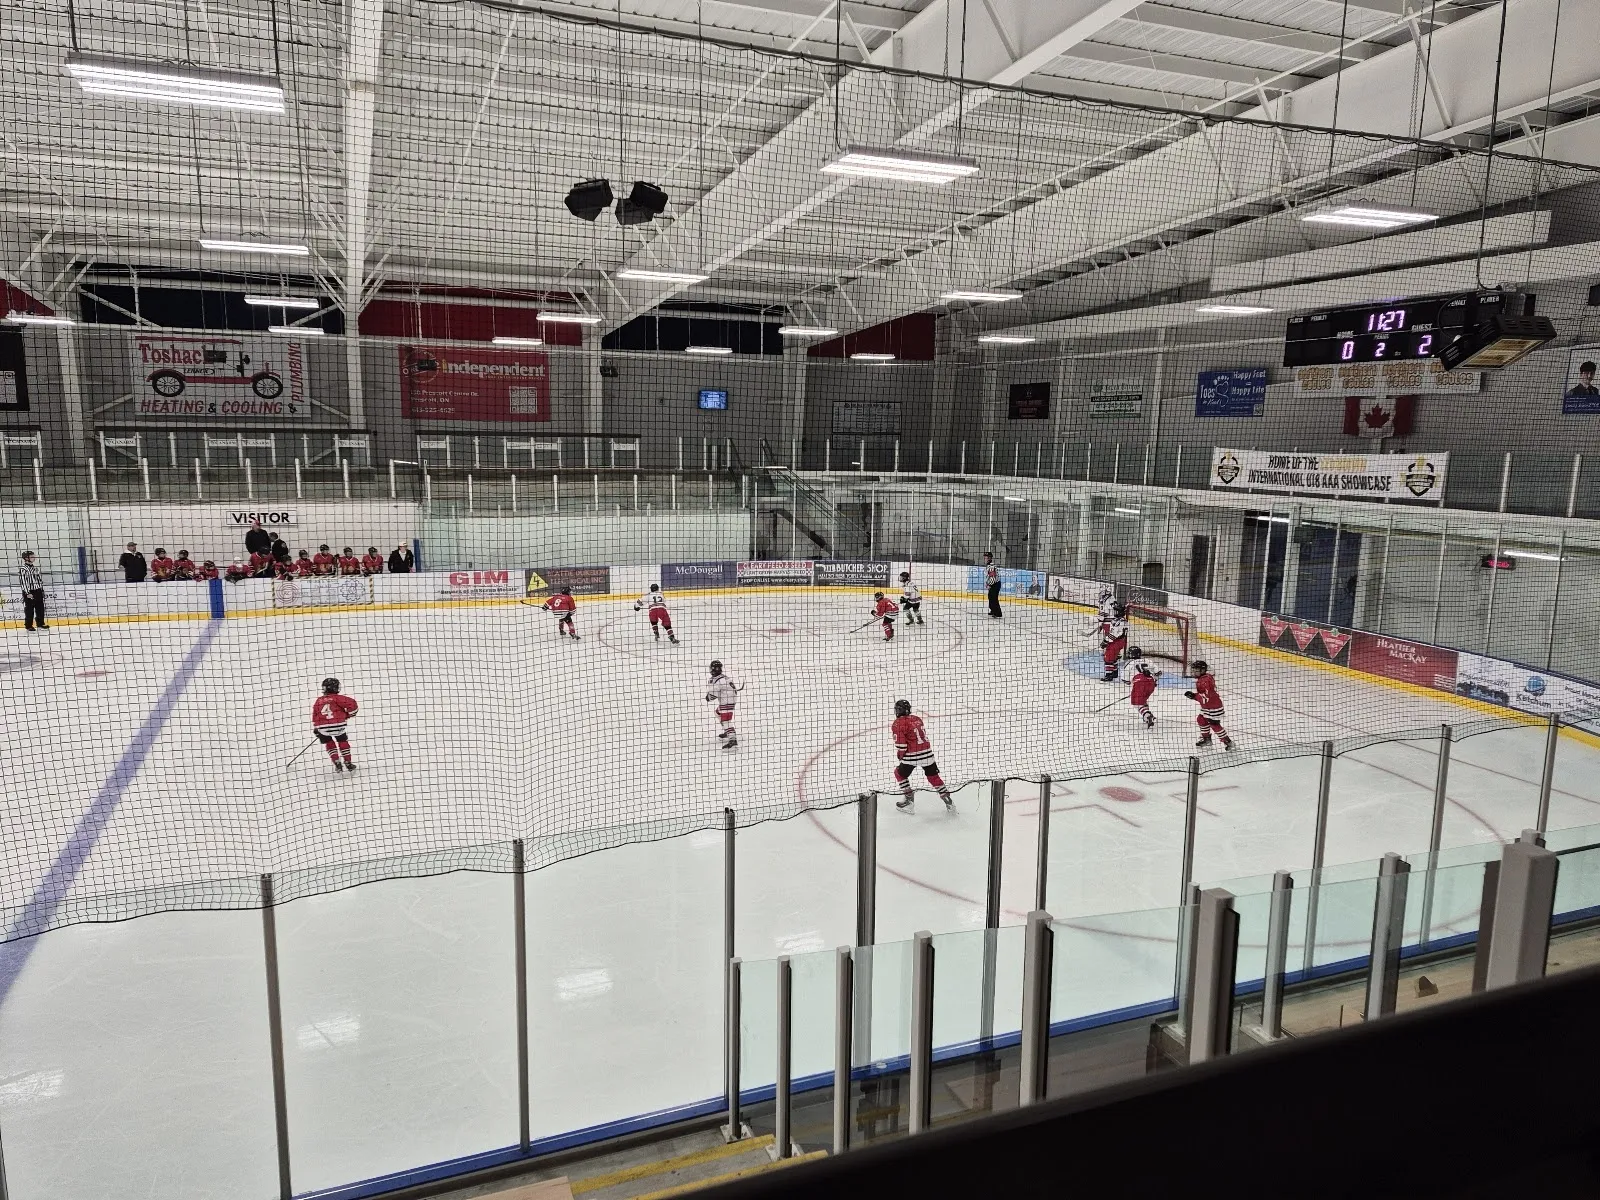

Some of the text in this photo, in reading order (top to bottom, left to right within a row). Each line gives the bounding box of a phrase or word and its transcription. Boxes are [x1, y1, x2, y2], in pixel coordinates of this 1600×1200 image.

[1342, 341, 1355, 360] 0
[1375, 342, 1386, 357] 2
[1418, 334, 1432, 355] 2
[287, 341, 305, 403] PLUMBING
[441, 359, 546, 379] independent
[1200, 384, 1215, 399] Toes
[140, 400, 298, 415] HEATING & COOLING &
[1268, 455, 1291, 469] HOME
[1291, 457, 1303, 470] OF
[1302, 457, 1320, 471] THE
[1247, 469, 1305, 487] INTERNATIONAL
[1321, 473, 1340, 489] AAA
[1341, 475, 1393, 491] SHOWCASE
[232, 512, 291, 524] VISITOR
[675, 564, 723, 575] McDougall
[836, 563, 865, 573] BUTCHER
[866, 563, 887, 574] SHOP
[449, 570, 509, 585] GIM
[1516, 693, 1552, 708] Ketchum
[321, 703, 334, 720] 4
